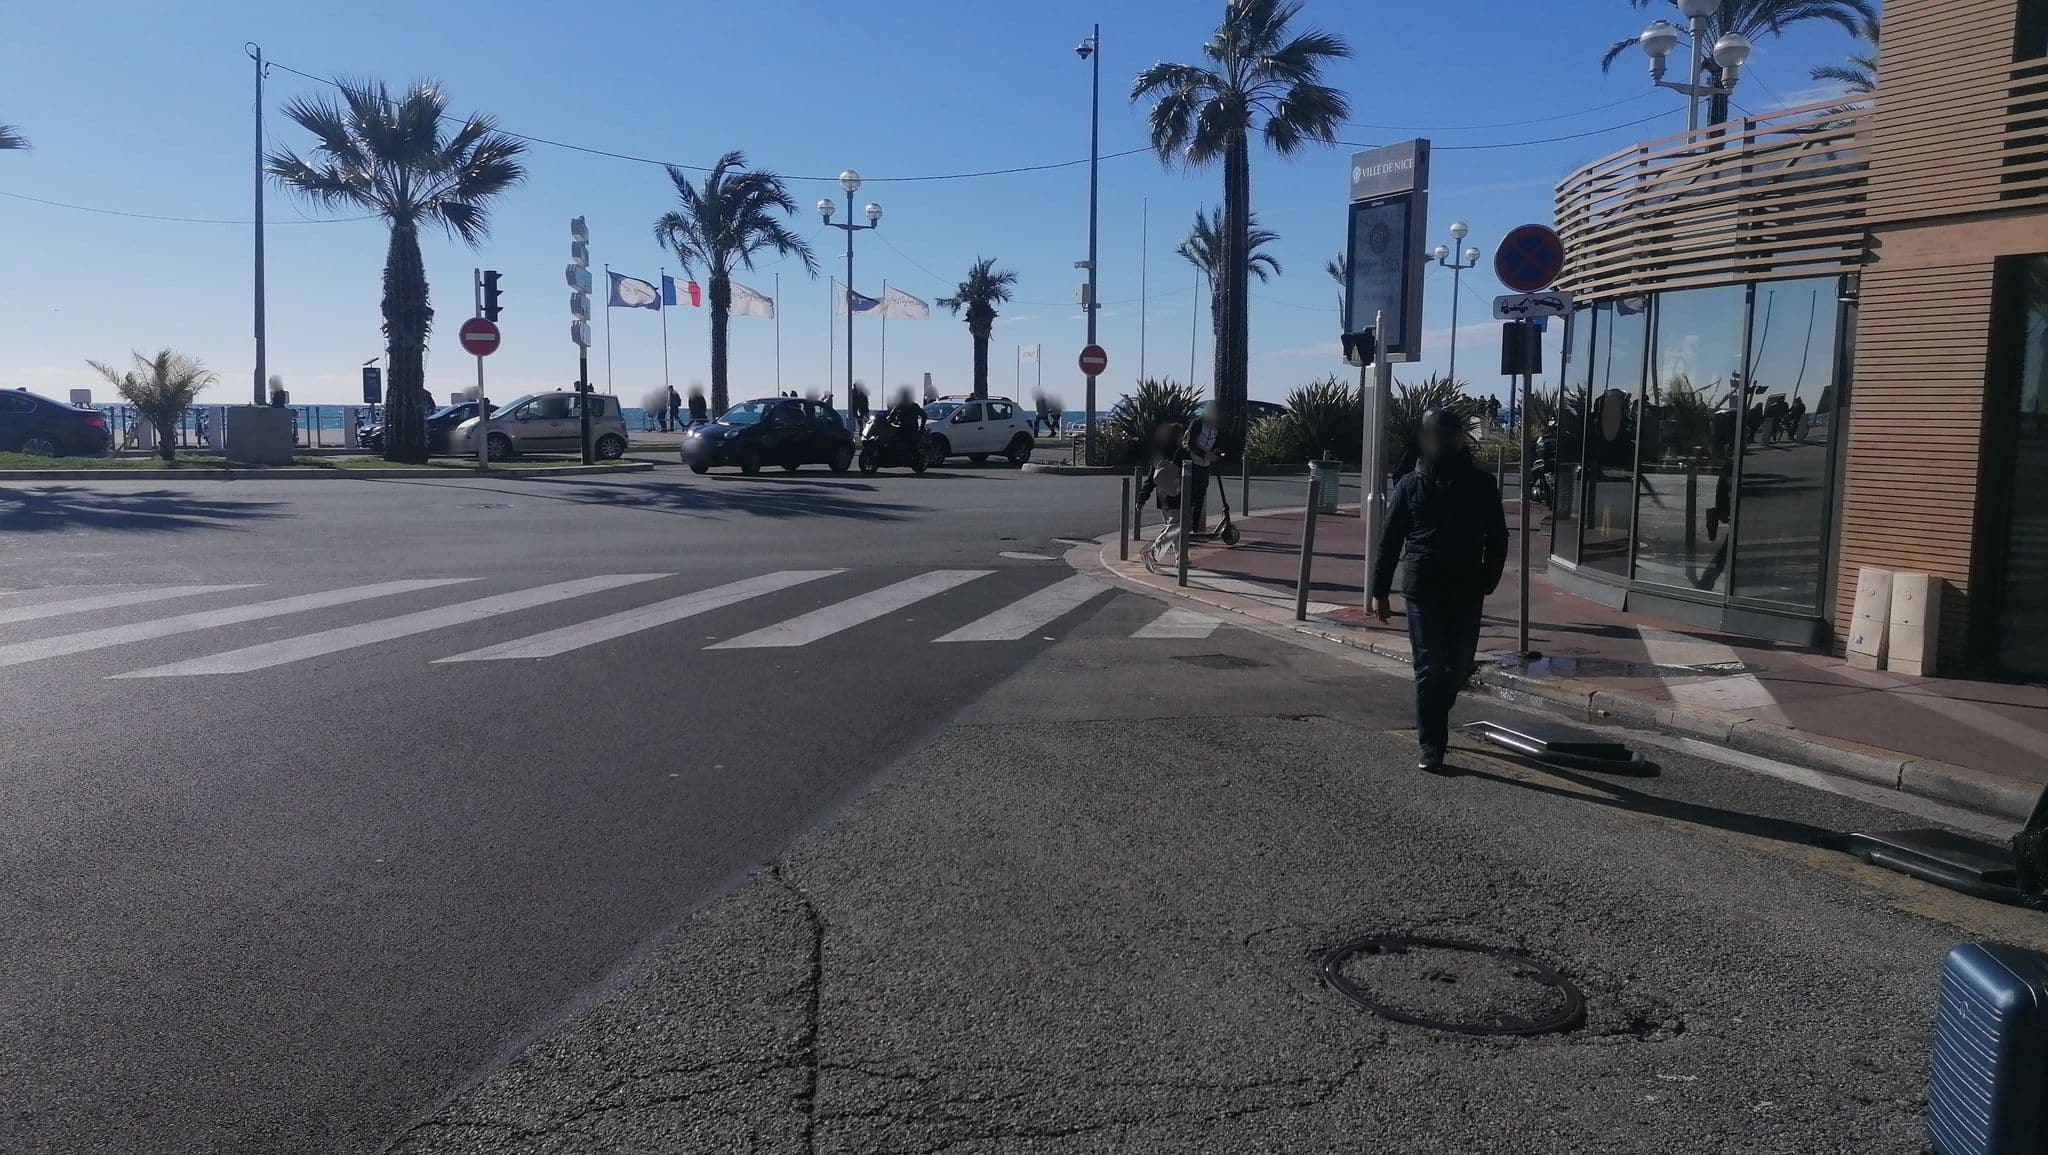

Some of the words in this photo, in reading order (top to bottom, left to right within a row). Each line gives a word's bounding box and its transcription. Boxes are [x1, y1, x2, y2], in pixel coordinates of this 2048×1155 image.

[1362, 165, 1381, 177] VILLE
[1382, 162, 1392, 174] DE
[1394, 158, 1413, 171] NICE
